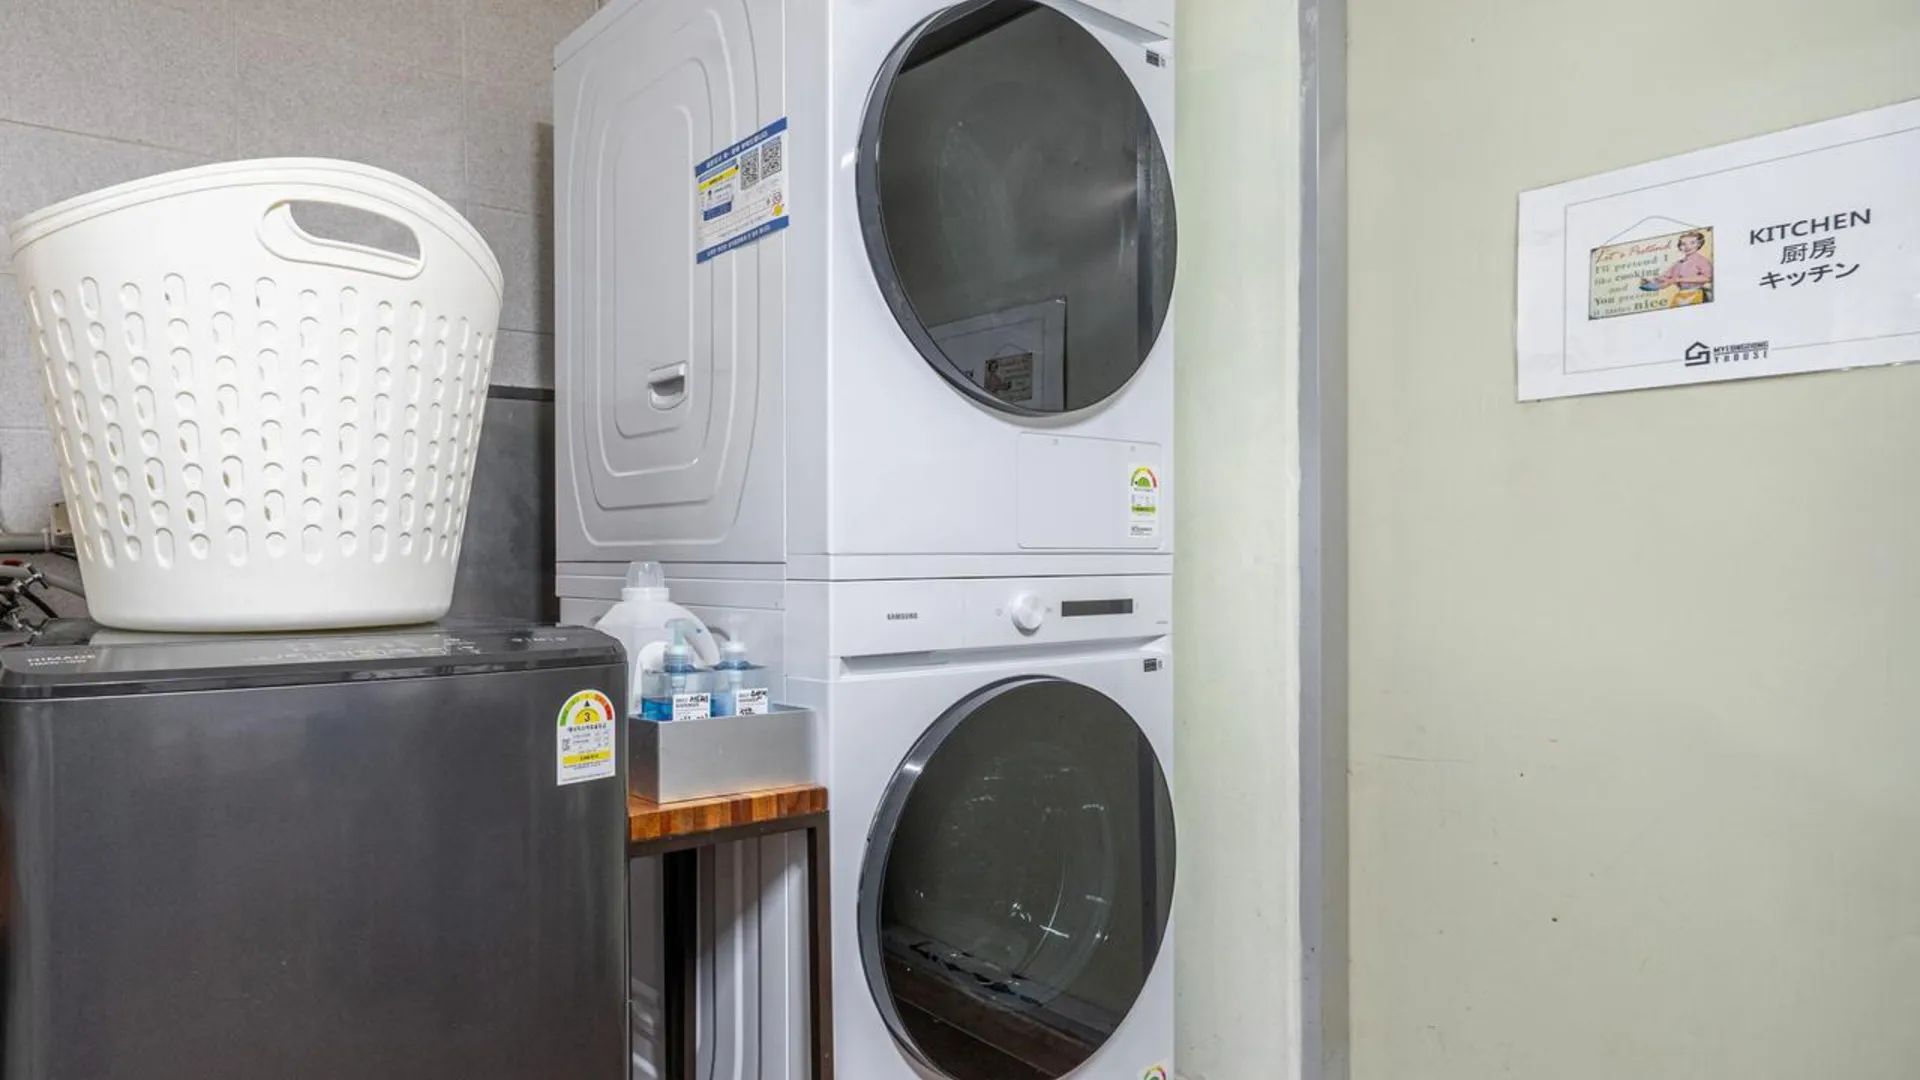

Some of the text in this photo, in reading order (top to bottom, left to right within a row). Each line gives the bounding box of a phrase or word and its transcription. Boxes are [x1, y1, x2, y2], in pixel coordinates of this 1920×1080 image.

[1750, 208, 1871, 245] KITCHEN
[1780, 236, 1836, 265] 厨房
[1614, 254, 1658, 273] pretend
[1615, 267, 1661, 282] cooking
[1759, 262, 1860, 289] キッチン
[1608, 283, 1629, 294] and
[1634, 298, 1669, 311] nice
[887, 612, 918, 621] SAMSUNG
[584, 711, 592, 722] 3
